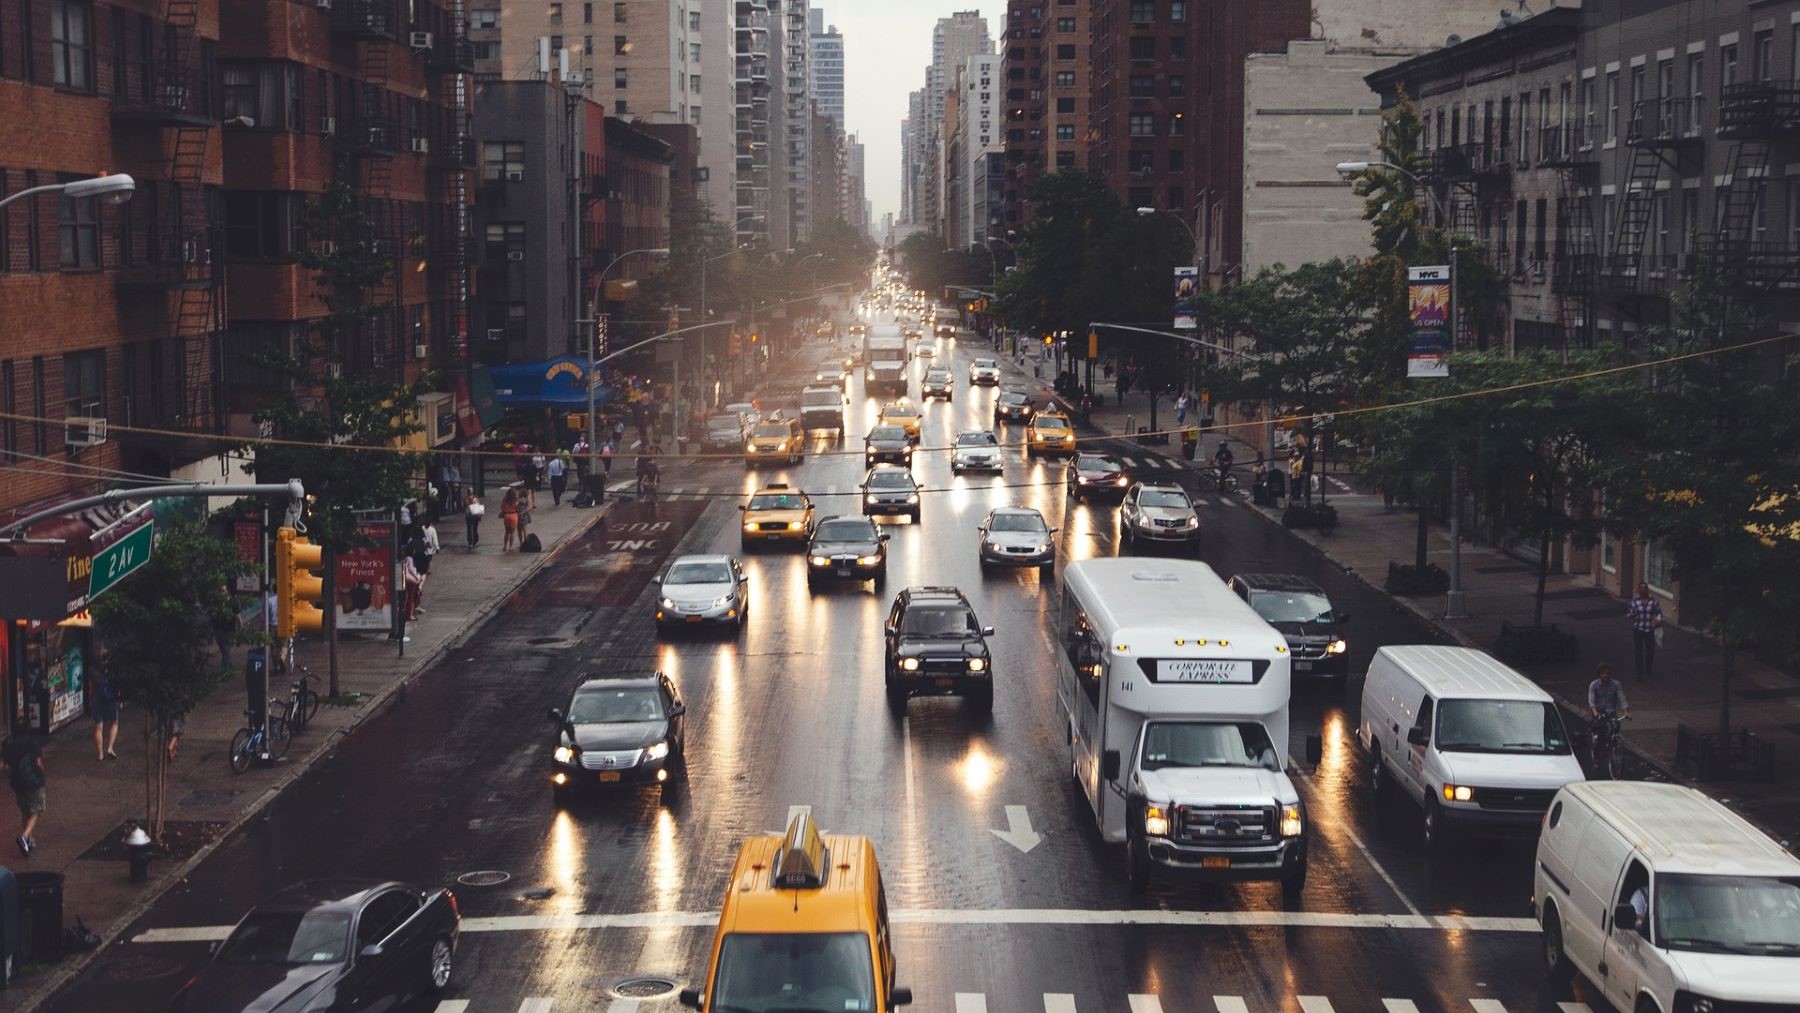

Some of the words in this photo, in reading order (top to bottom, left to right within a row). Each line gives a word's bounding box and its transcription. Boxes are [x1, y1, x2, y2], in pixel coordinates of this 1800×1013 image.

[1424, 319, 1444, 327] OPEN
[108, 553, 117, 578] 2
[341, 560, 359, 568] New
[361, 560, 384, 568] York's
[350, 568, 375, 576] Finest
[254, 661, 262, 671] P
[1169, 661, 1238, 671] CORPORATE
[1179, 671, 1230, 680] EXPRESS
[1121, 682, 1133, 692] 141
